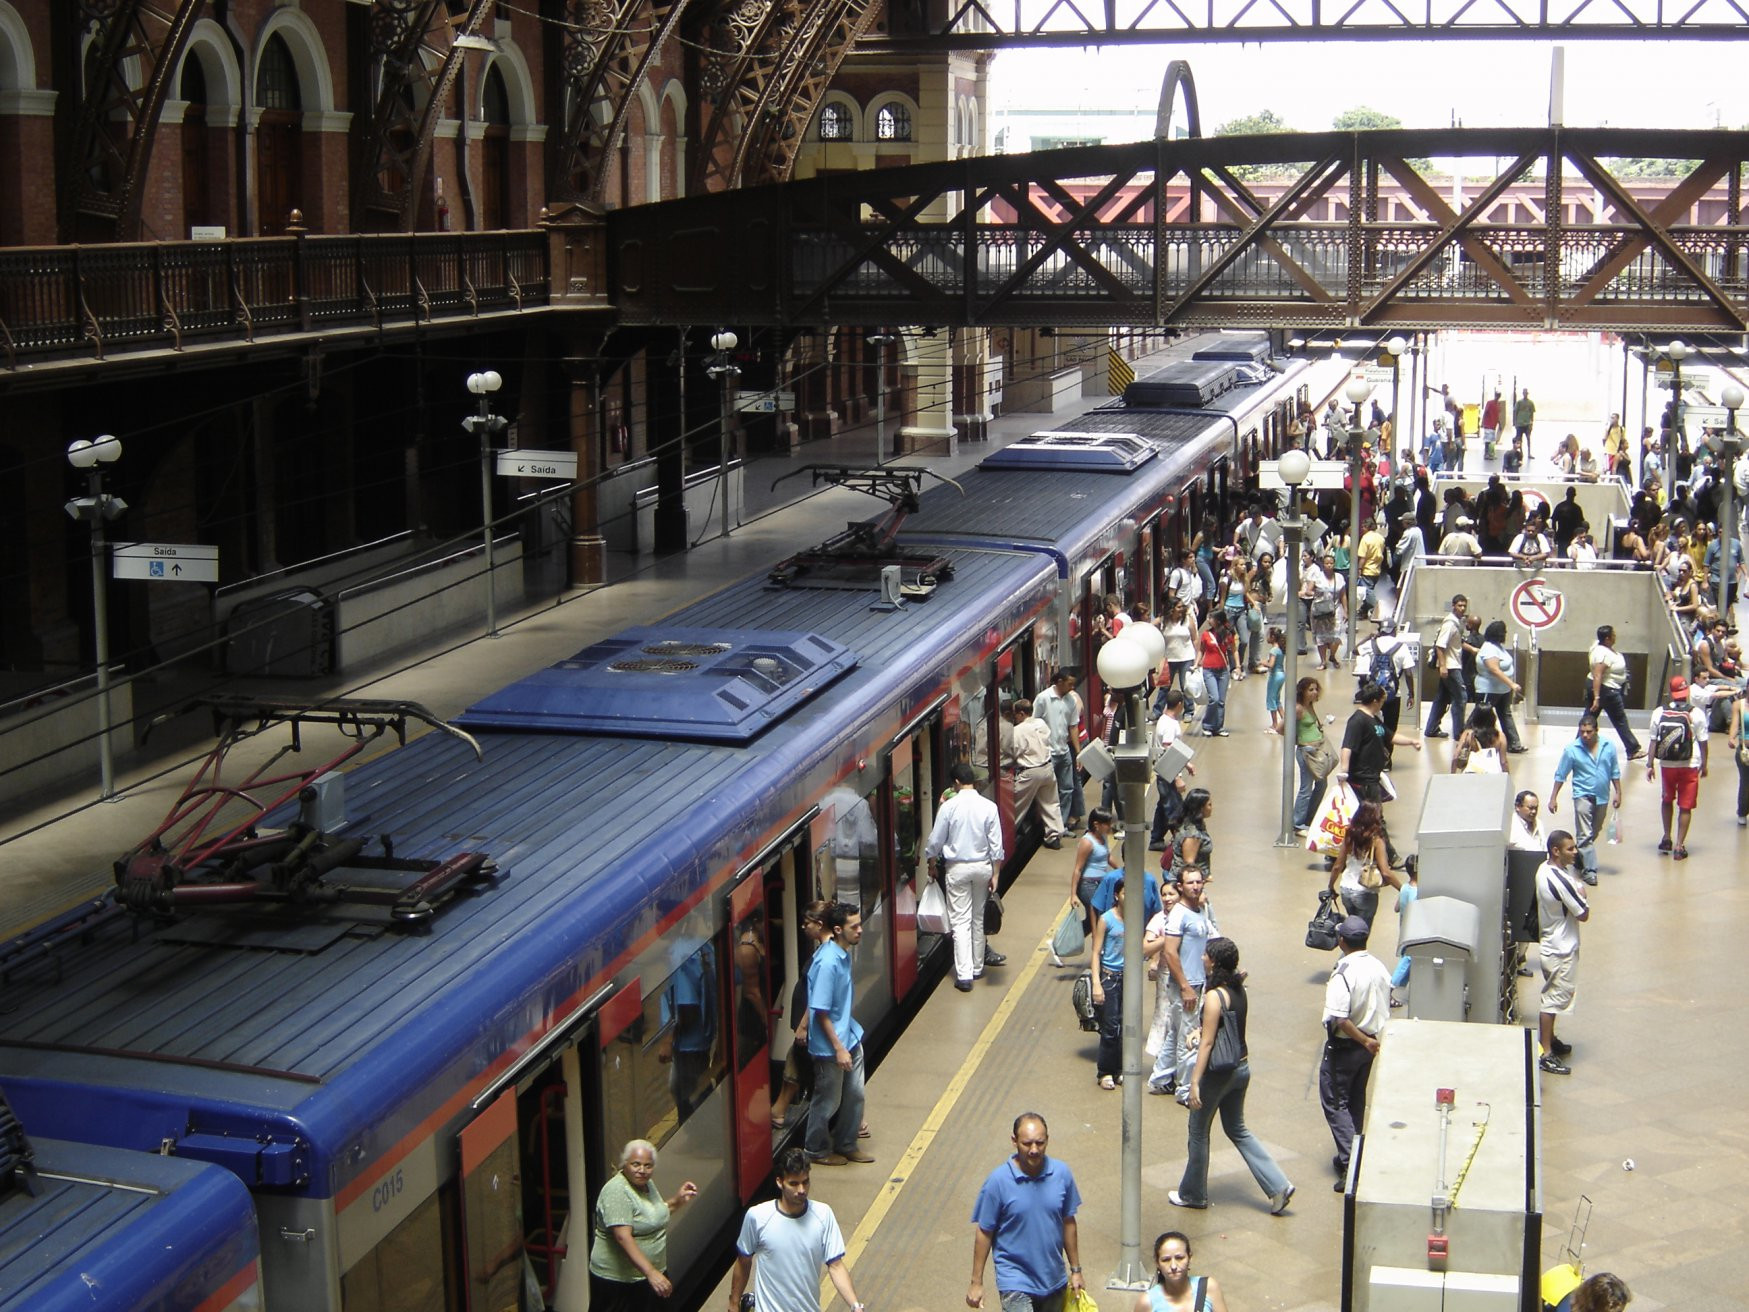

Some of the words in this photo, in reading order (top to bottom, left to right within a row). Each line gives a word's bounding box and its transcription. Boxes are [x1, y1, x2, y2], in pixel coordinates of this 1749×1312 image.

[531, 465, 556, 474] Saída
[154, 547, 177, 556] Saída
[373, 1168, 404, 1213] C015
